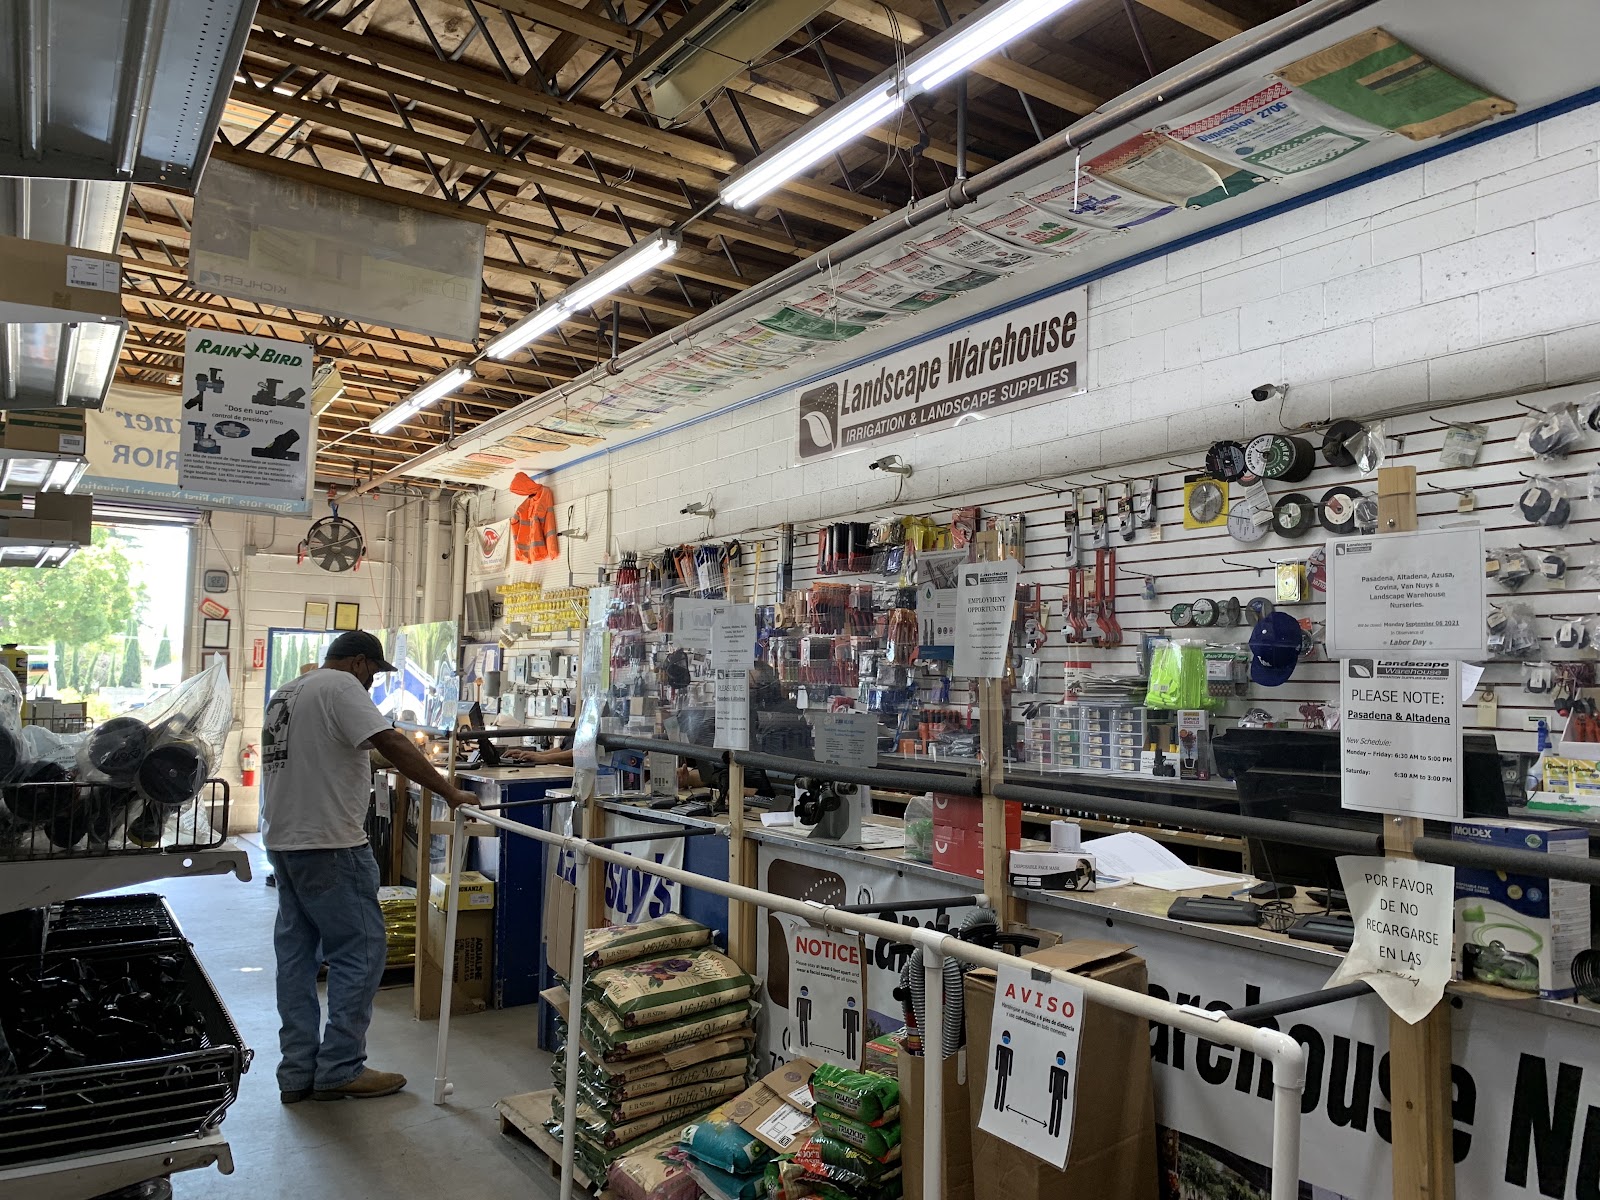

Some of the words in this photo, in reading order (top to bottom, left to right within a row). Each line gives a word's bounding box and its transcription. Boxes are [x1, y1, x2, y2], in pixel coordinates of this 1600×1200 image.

[1197, 117, 1255, 142] Dimension
[1257, 101, 1288, 119] 270G
[195, 338, 242, 358] RAIN
[260, 348, 302, 367] BIRD
[840, 356, 941, 417] Landscape
[947, 310, 1078, 384] Warehouse
[846, 413, 906, 443] IRRIGATION
[909, 412, 917, 425] &
[920, 389, 996, 423] LANDSCAPE
[1000, 368, 1069, 401] SUPPLIES
[1397, 573, 1429, 581] Altadena,
[968, 596, 1006, 605] EMPLOYMENT
[1370, 592, 1405, 600] Landscape
[1406, 591, 1446, 599] Warehouse
[968, 605, 1007, 613] OPPORTUNITY
[1377, 661, 1449, 669] Landscape
[1351, 689, 1398, 703] PLEASE
[1402, 691, 1444, 705] NOTE:
[1348, 710, 1393, 721] Pasadena
[1395, 713, 1403, 721] &
[1405, 712, 1450, 724] Altadena
[1360, 738, 1392, 746] Schedule:
[1346, 749, 1366, 757] Monday
[1372, 751, 1394, 759] Friday:
[1345, 767, 1371, 776] Saturday:
[1365, 874, 1388, 887] POR
[1392, 877, 1434, 895] FAVOR
[1380, 899, 1396, 913] DE
[1400, 902, 1419, 916] NO
[1366, 918, 1439, 946] RECARGARSE
[475, 937, 483, 980] AQUALINE
[796, 936, 859, 965] NOTICE
[1379, 946, 1396, 960] EN
[1401, 950, 1422, 966] LAS
[1005, 983, 1075, 1018] AVISO
[1057, 1021, 1075, 1032] distancia
